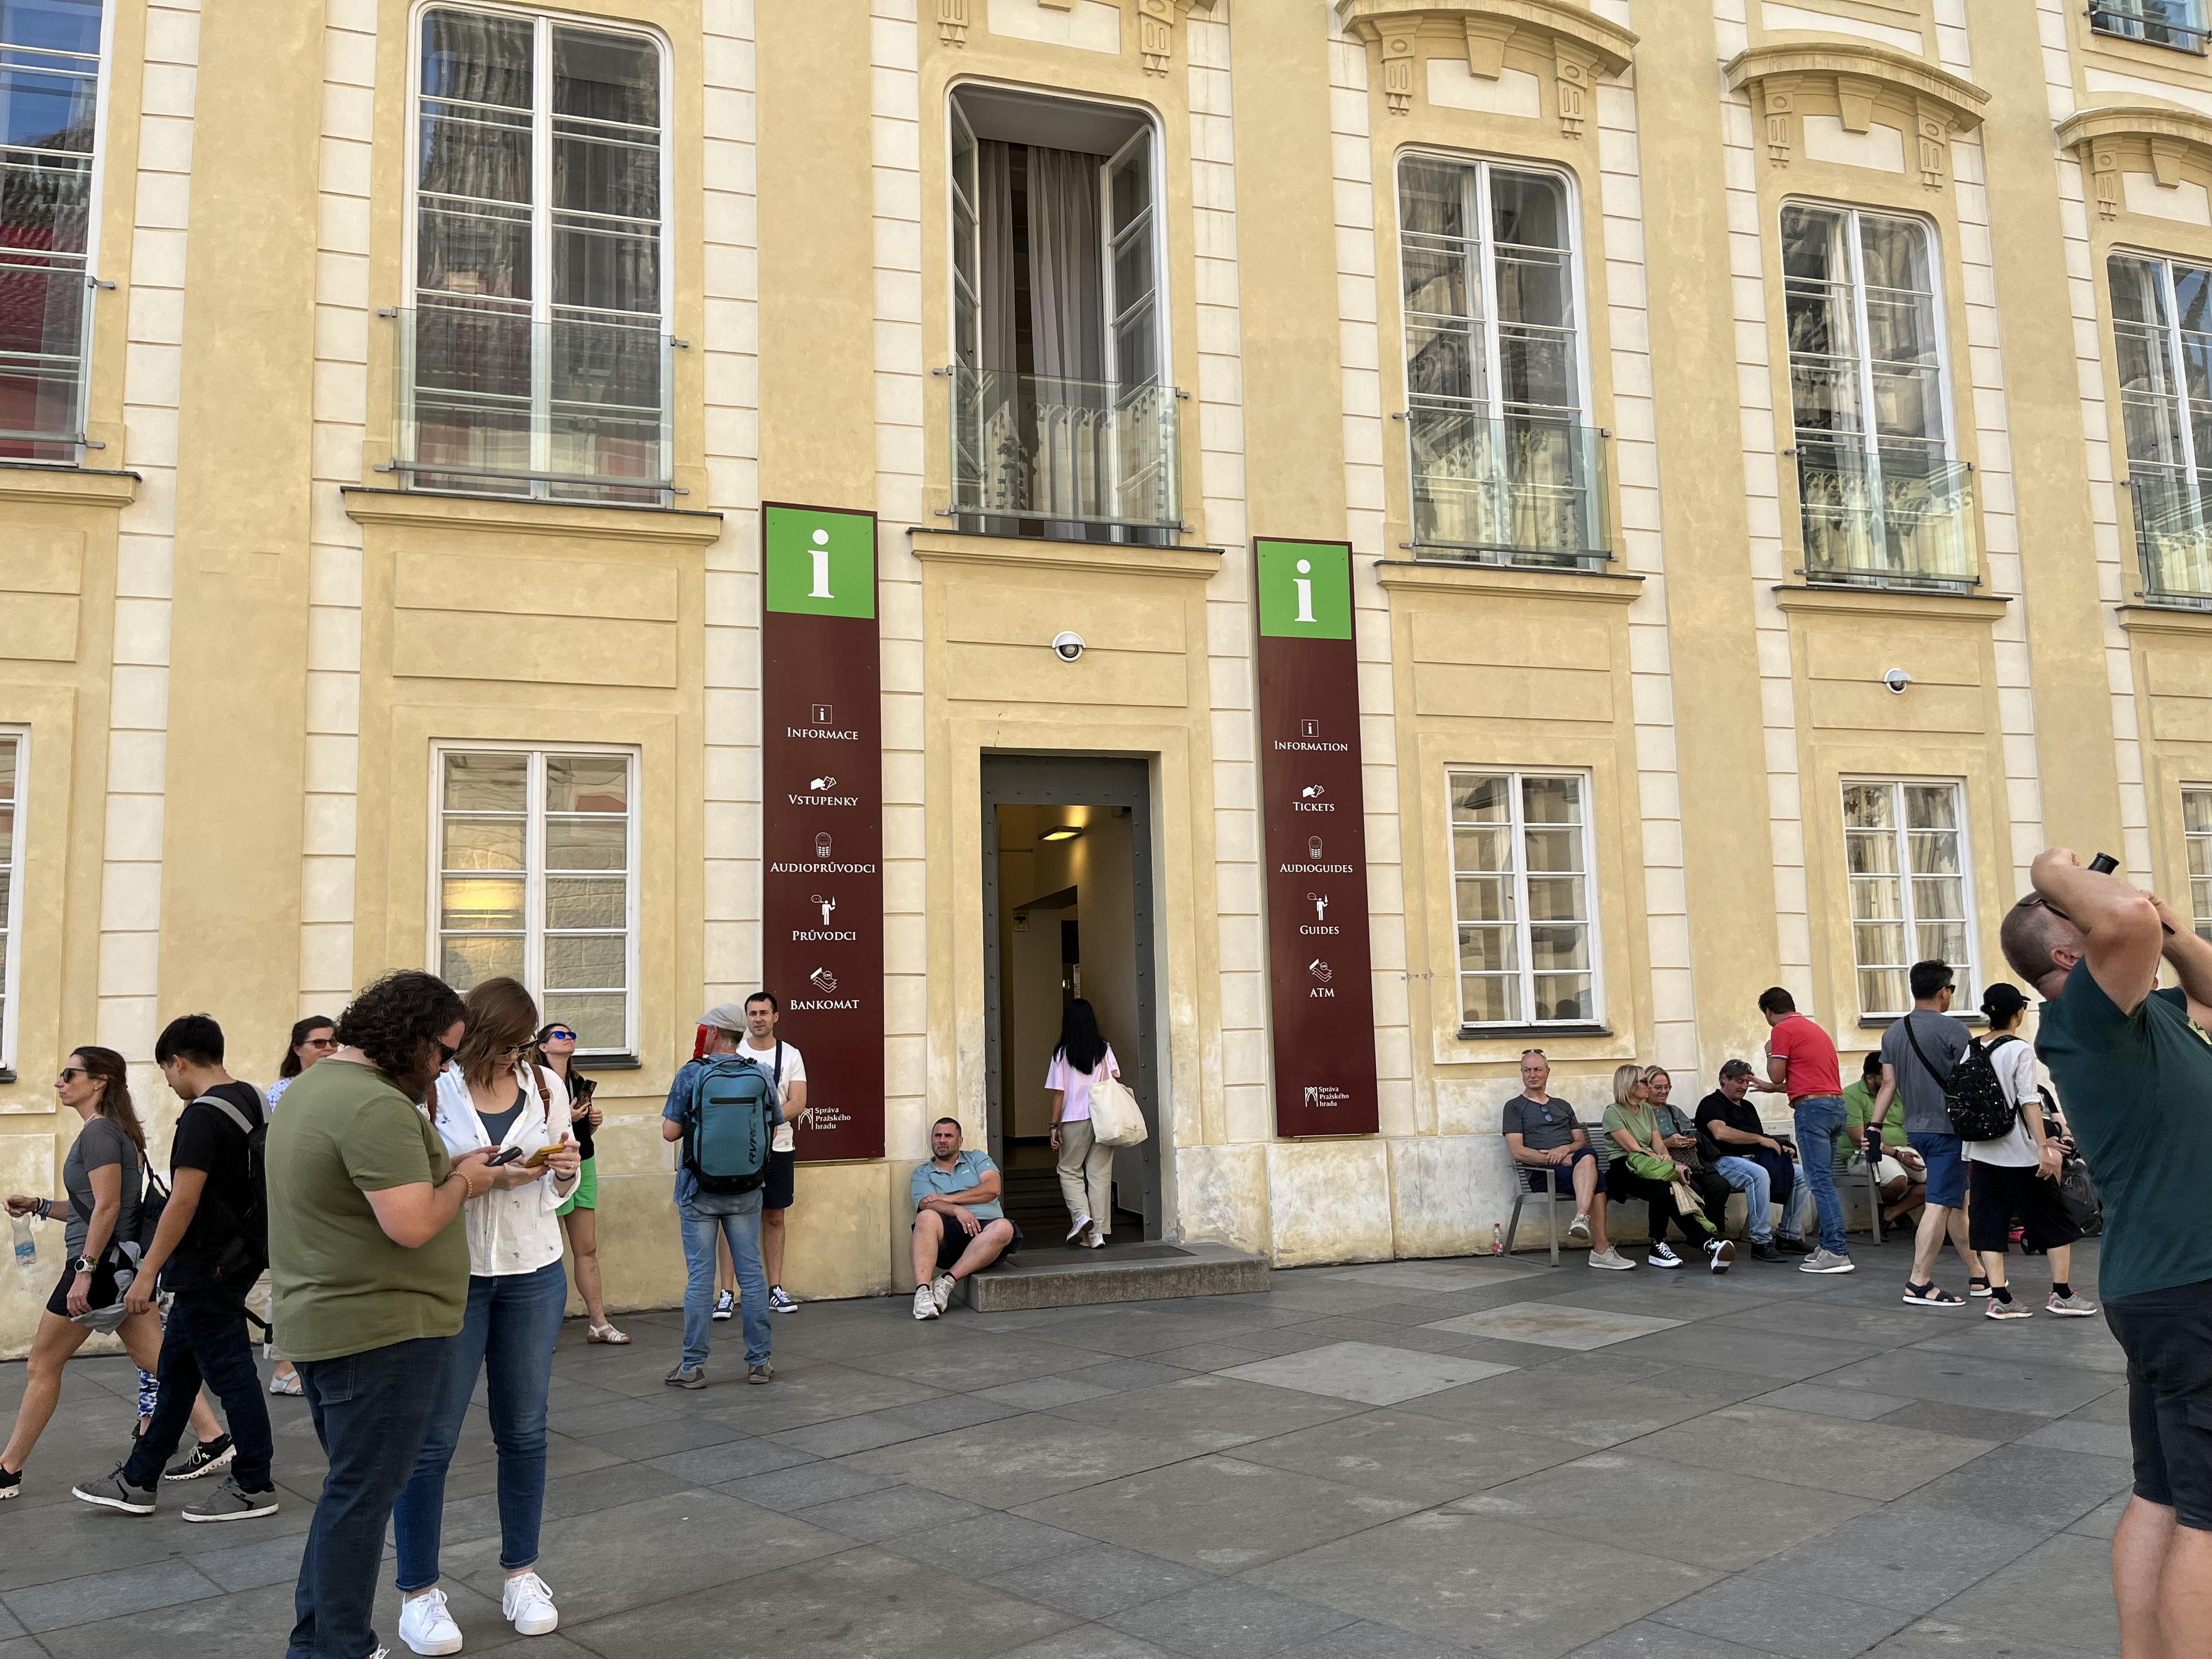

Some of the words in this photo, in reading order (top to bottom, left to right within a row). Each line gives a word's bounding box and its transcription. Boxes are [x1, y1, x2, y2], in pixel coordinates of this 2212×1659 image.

[808, 529, 834, 598] i
[1293, 559, 1317, 622] i
[787, 727, 859, 740] INFORMACE
[1274, 740, 1348, 751] INFORMATION
[788, 794, 859, 806] VSTUPENKY
[1292, 801, 1335, 811] TICKETS
[770, 861, 875, 873] AUDIOPRŮVODCI
[1280, 863, 1353, 873] AUDIOGUIDES
[792, 929, 856, 941] PRŮVODCI
[1300, 925, 1339, 935] GUIDES
[1310, 988, 1335, 998] ATM
[790, 999, 860, 1010] BANKOMAT
[815, 1107, 839, 1115] Správa
